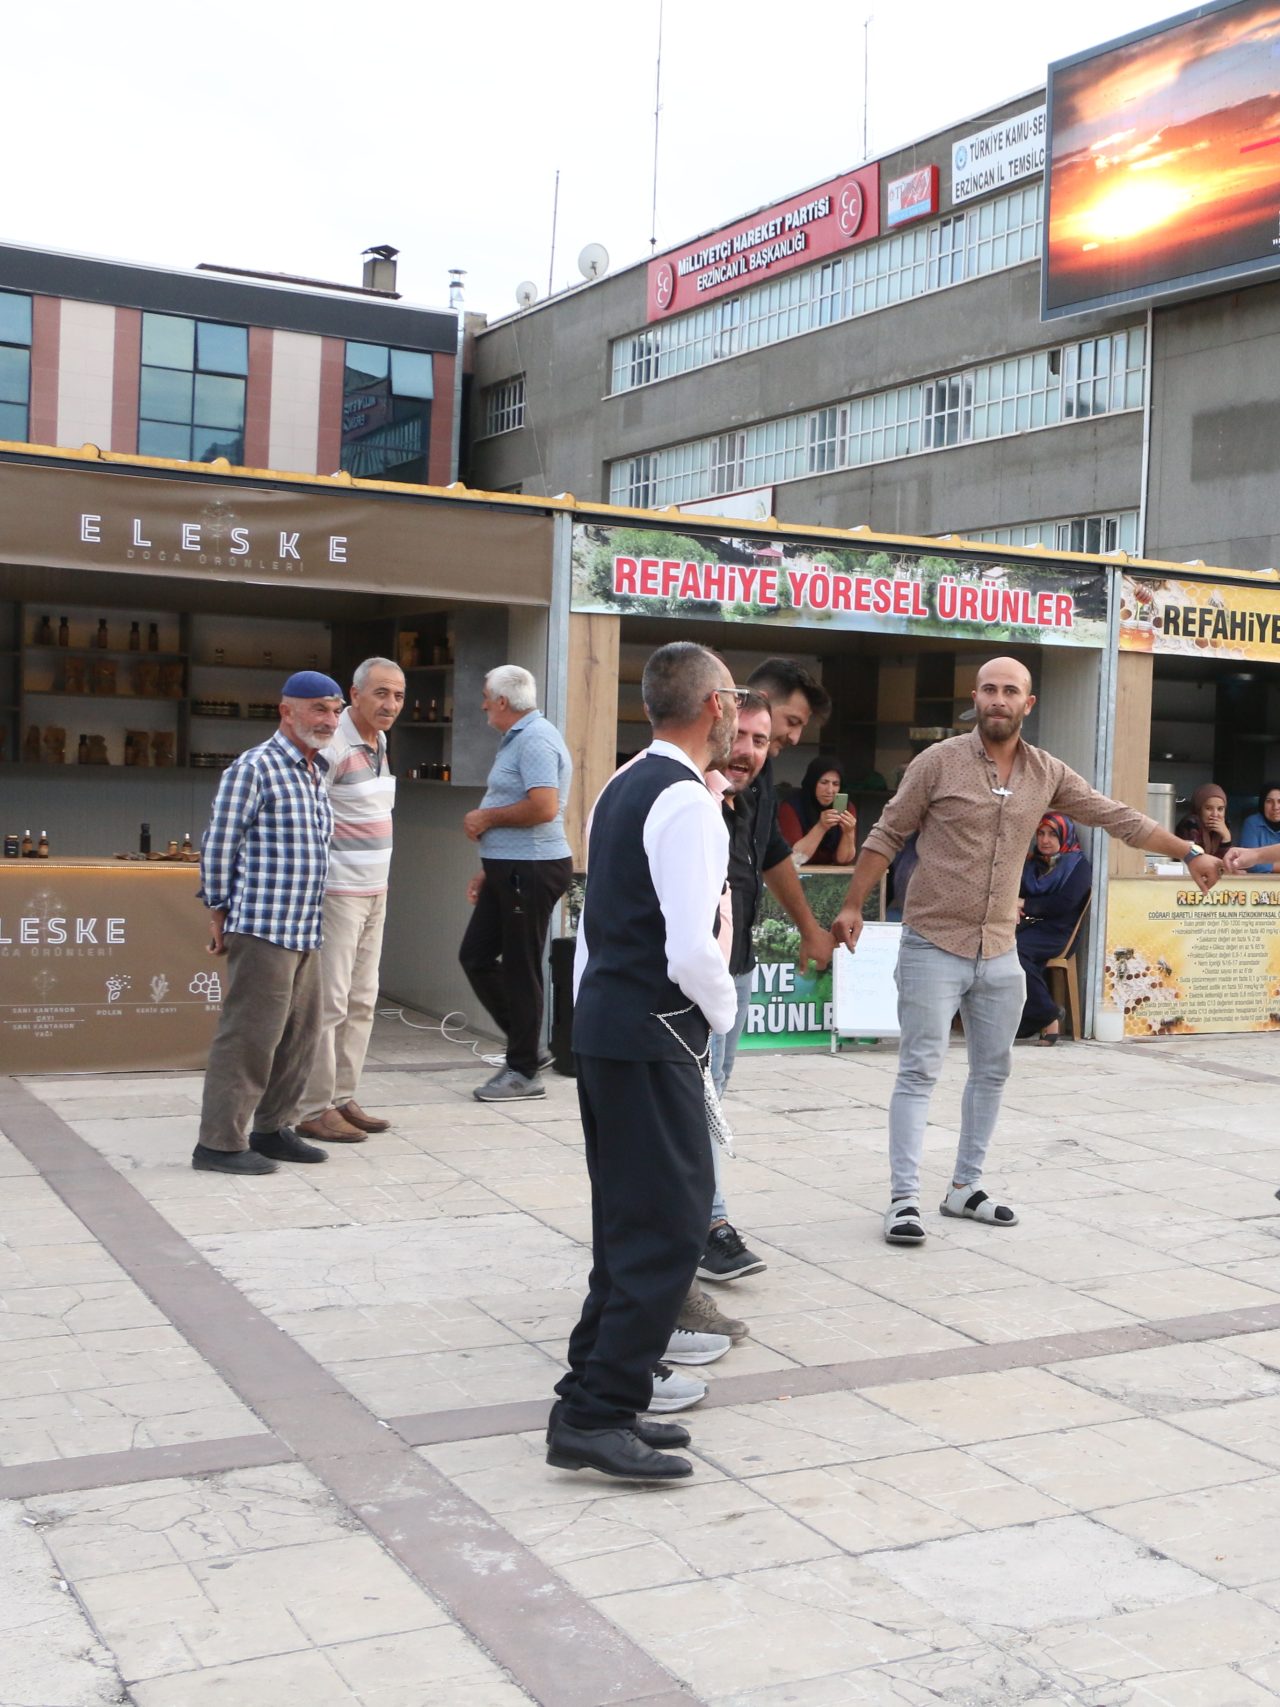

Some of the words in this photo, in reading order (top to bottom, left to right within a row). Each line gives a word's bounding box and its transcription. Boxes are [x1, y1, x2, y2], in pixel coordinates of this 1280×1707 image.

[970, 131, 1003, 162] TÜRKİYE
[955, 173, 995, 199] ERZİNCAN
[733, 219, 782, 250] HAREKET
[750, 232, 805, 269] BAŞKANLIĞI
[81, 514, 347, 562] ELESKE
[787, 563, 928, 617] YÖRESEL
[937, 576, 1074, 628] ÜRÜNLER
